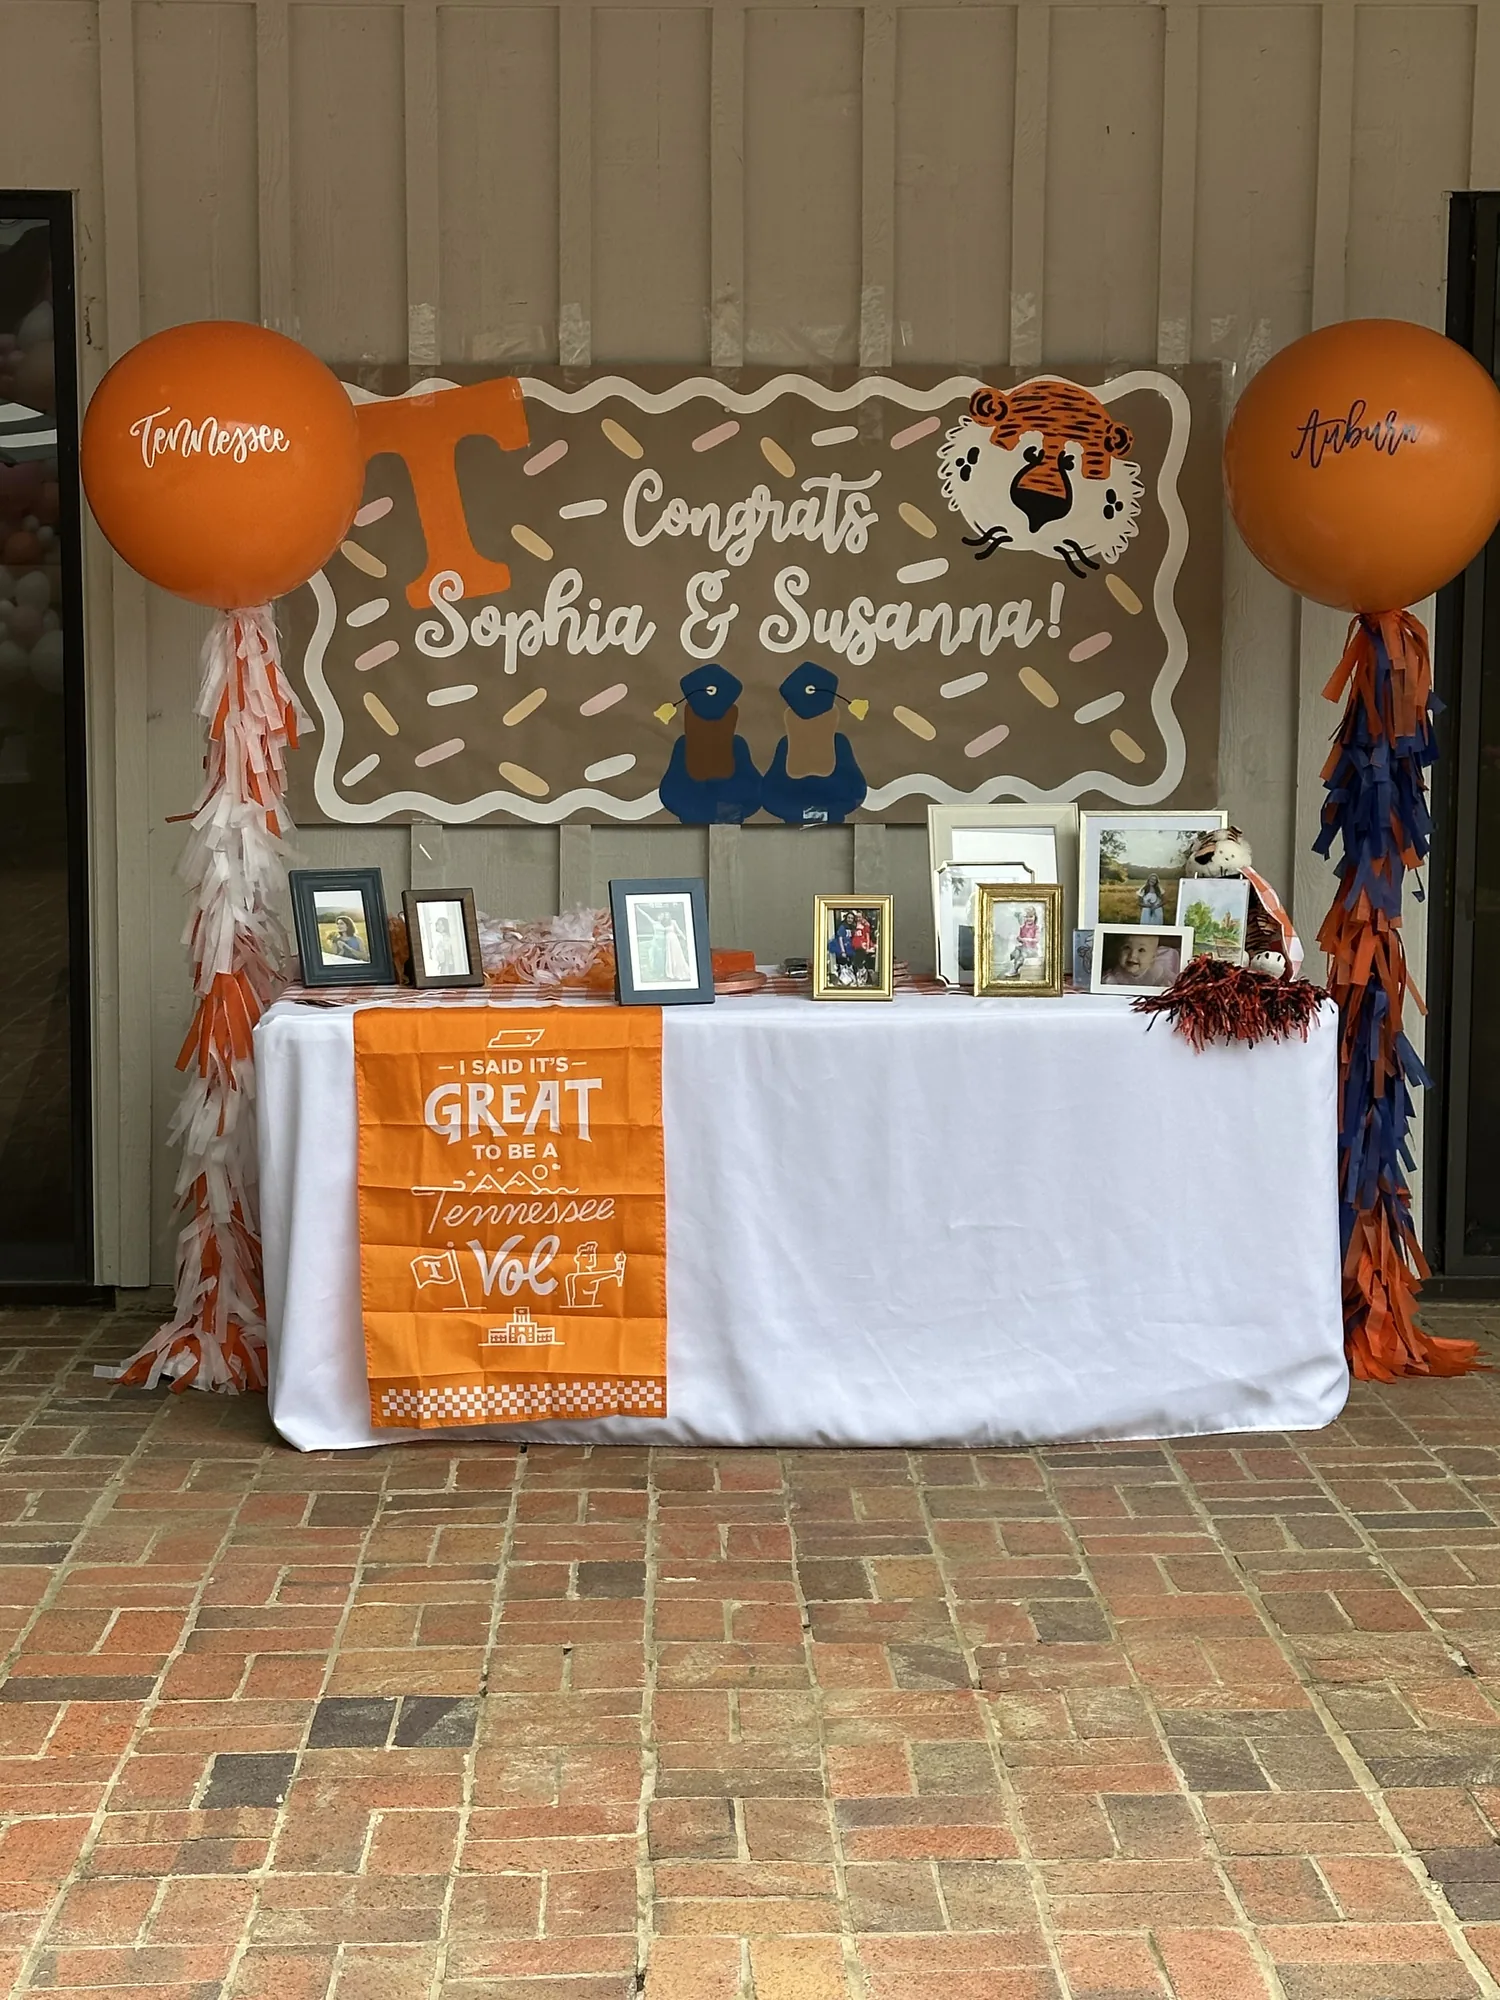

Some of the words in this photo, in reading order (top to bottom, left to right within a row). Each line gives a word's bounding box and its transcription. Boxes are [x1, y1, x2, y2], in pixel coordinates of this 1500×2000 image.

[129, 406, 291, 469] Tennessee
[1291, 399, 1421, 469] Auburn
[355, 376, 530, 609] T
[622, 468, 883, 567] Congrats
[415, 569, 658, 675] Sophia
[680, 567, 741, 660] &
[758, 565, 1064, 666] Susanna!
[459, 1060, 466, 1075] I
[472, 1059, 524, 1075] SAID
[529, 1056, 569, 1074] IT'S
[424, 1077, 603, 1145] GREAT
[472, 1144, 502, 1160] TO
[508, 1143, 536, 1159] BE
[542, 1142, 559, 1158] A
[411, 1179, 615, 1234] Tennessee
[422, 1260, 444, 1280] T
[465, 1234, 561, 1297] Vol
